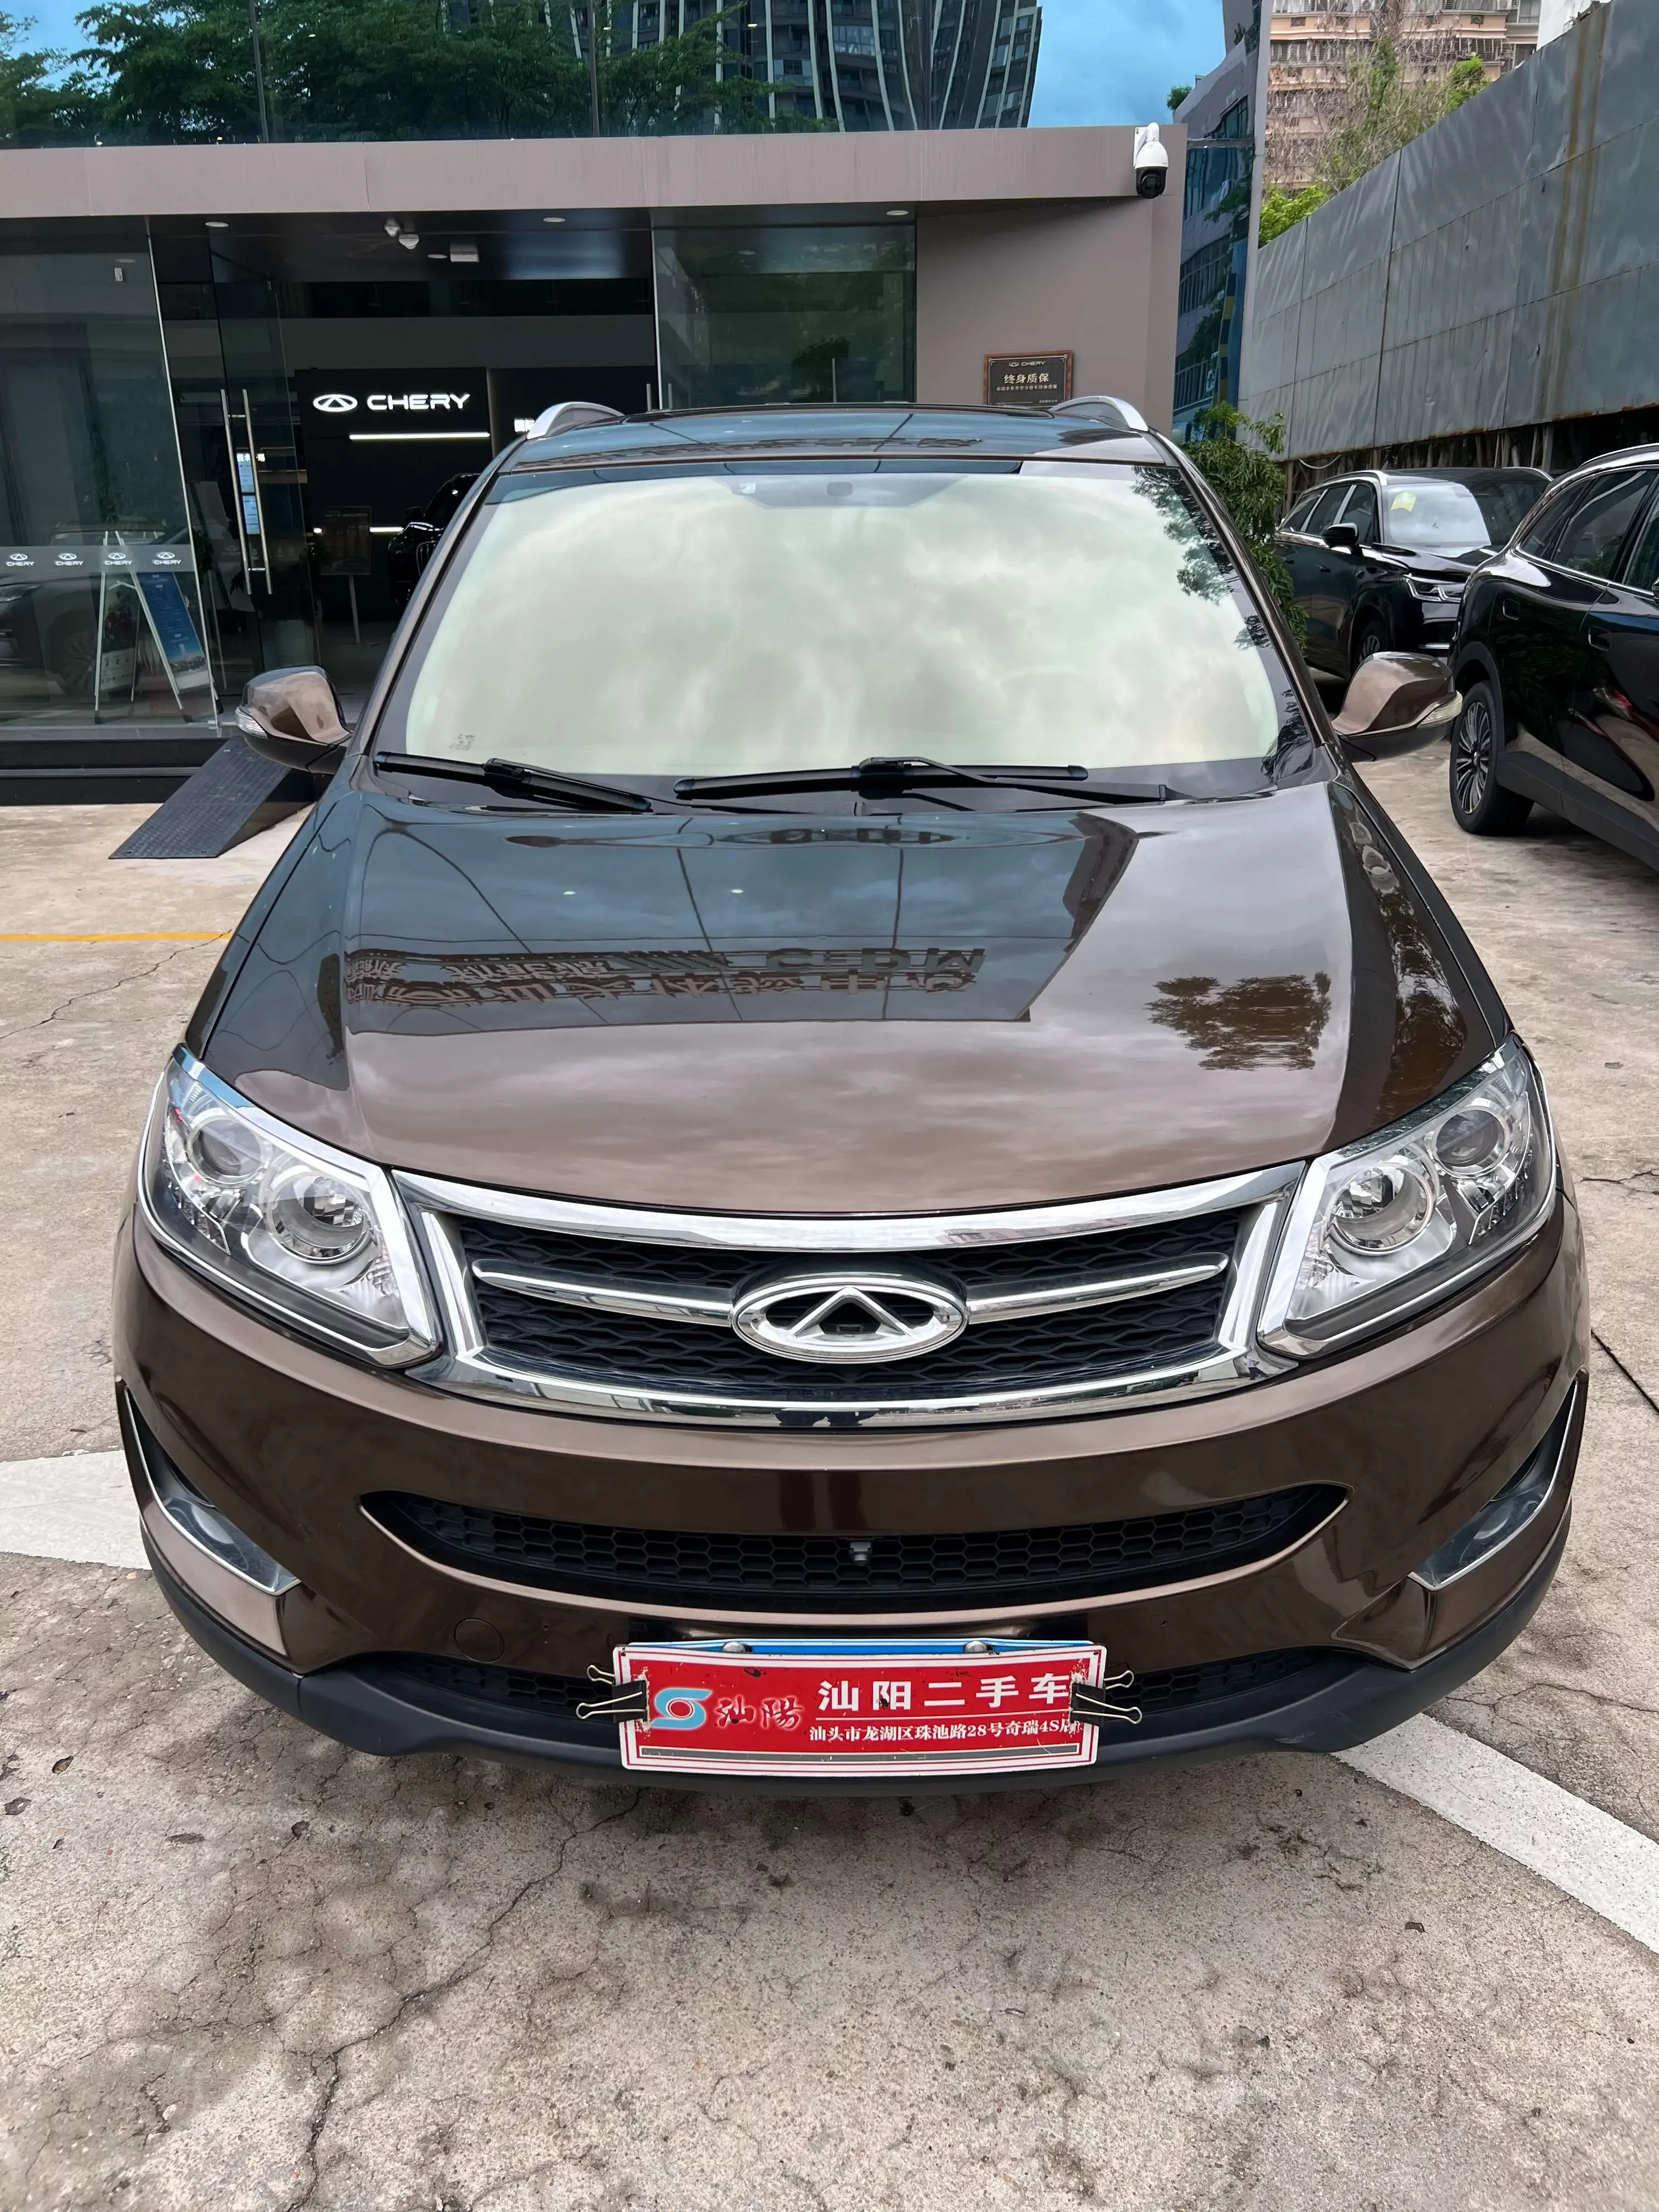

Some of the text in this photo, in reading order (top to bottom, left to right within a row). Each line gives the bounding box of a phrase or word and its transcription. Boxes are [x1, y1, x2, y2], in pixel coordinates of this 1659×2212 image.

[1003, 373, 1049, 384] 终身质保
[366, 393, 471, 410] CHERY
[817, 1672, 1070, 1712] 汕阳二手车
